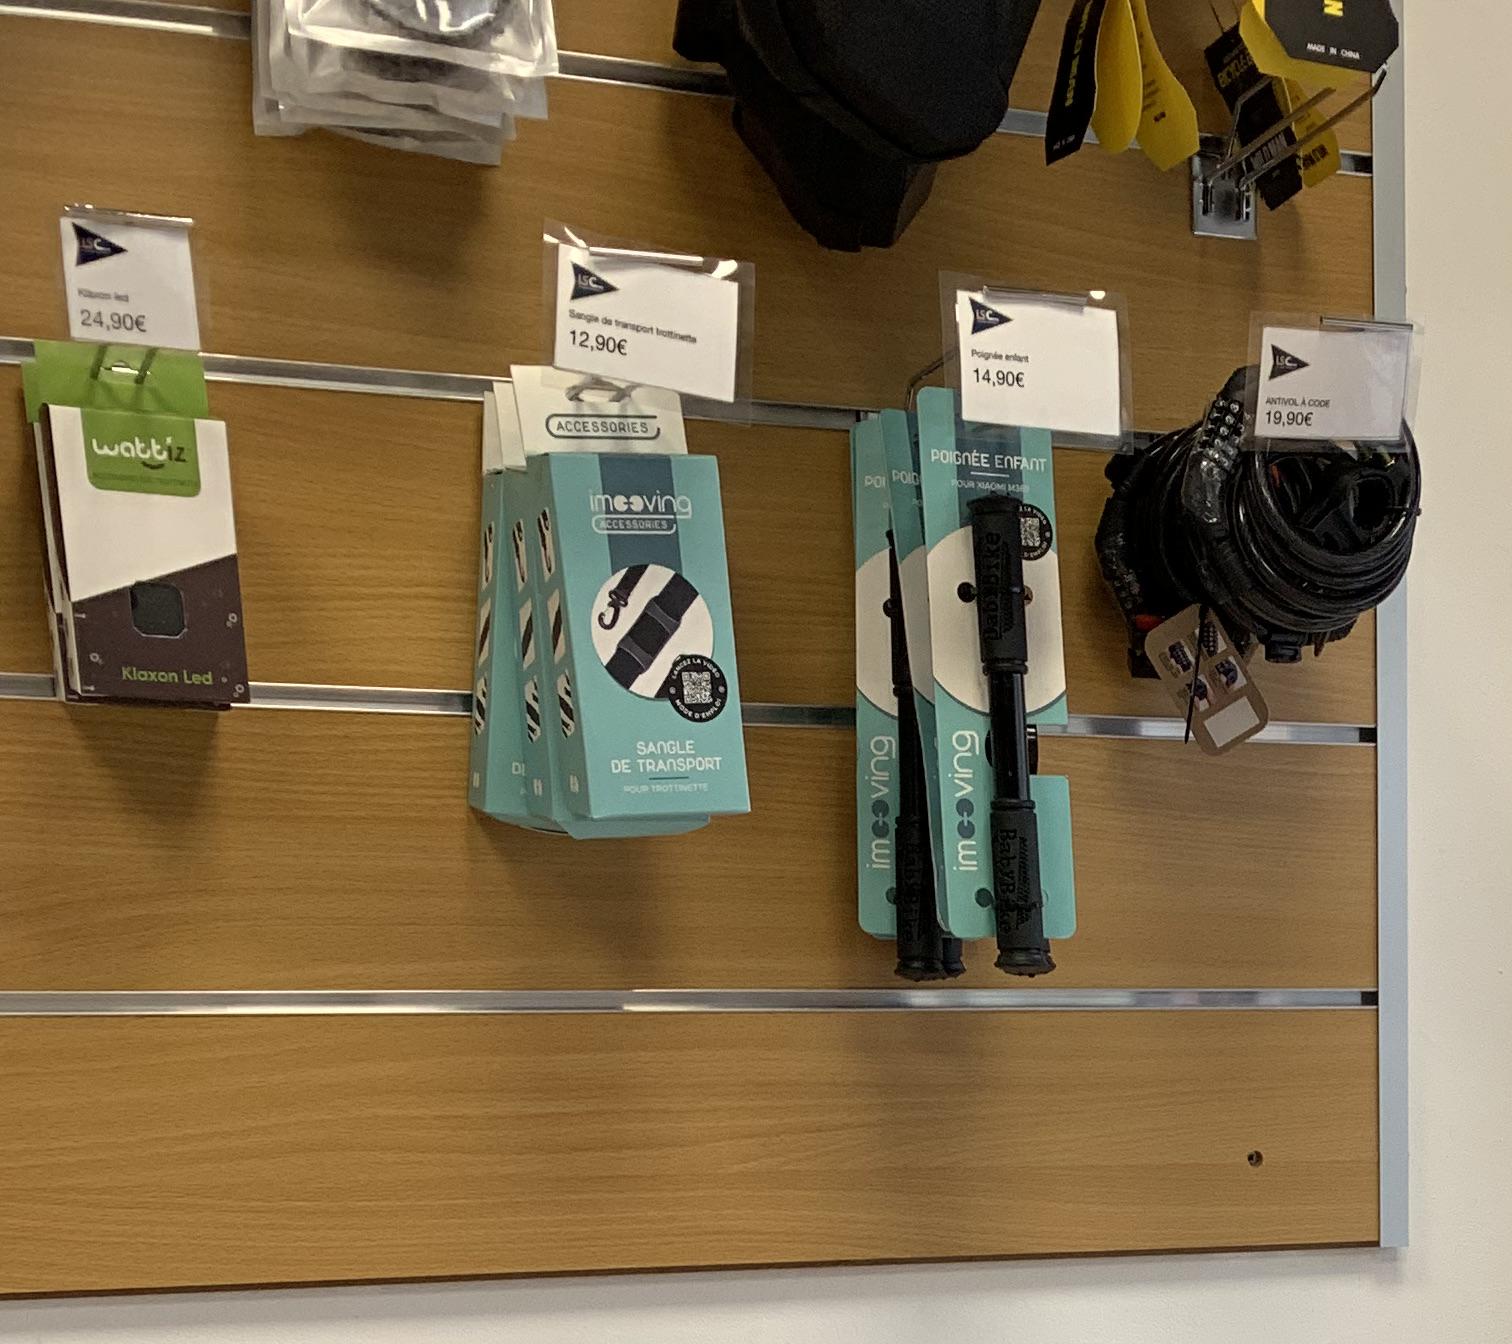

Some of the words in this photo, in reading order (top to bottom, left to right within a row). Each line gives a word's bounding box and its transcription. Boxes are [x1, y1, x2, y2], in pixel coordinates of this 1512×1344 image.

[1307, 42, 1325, 53] MADE
[1329, 47, 1337, 55] IN
[1341, 48, 1360, 59] CHINA
[80, 309, 147, 333] 24,90€
[569, 309, 599, 323] Sangle
[601, 316, 612, 326] de
[615, 319, 654, 335] transport
[569, 330, 628, 355] 12,90€
[971, 349, 1003, 361] Poignée
[973, 368, 1025, 388] 14,90€
[1265, 397, 1299, 407] ANTIVOL
[1308, 399, 1330, 408] CODE
[556, 420, 649, 433] ACCESSORIES
[1265, 410, 1314, 427] 19,90€
[92, 436, 188, 463] wattiz
[931, 449, 990, 468] POIGNÉE
[995, 455, 1047, 473] ENFANT
[600, 519, 668, 530] ACCESSORIES
[122, 667, 178, 683] Klaxon
[183, 670, 213, 684] Led
[636, 740, 696, 755] SANGLE
[611, 759, 631, 773] DE
[637, 756, 722, 773] TRANSPORT
